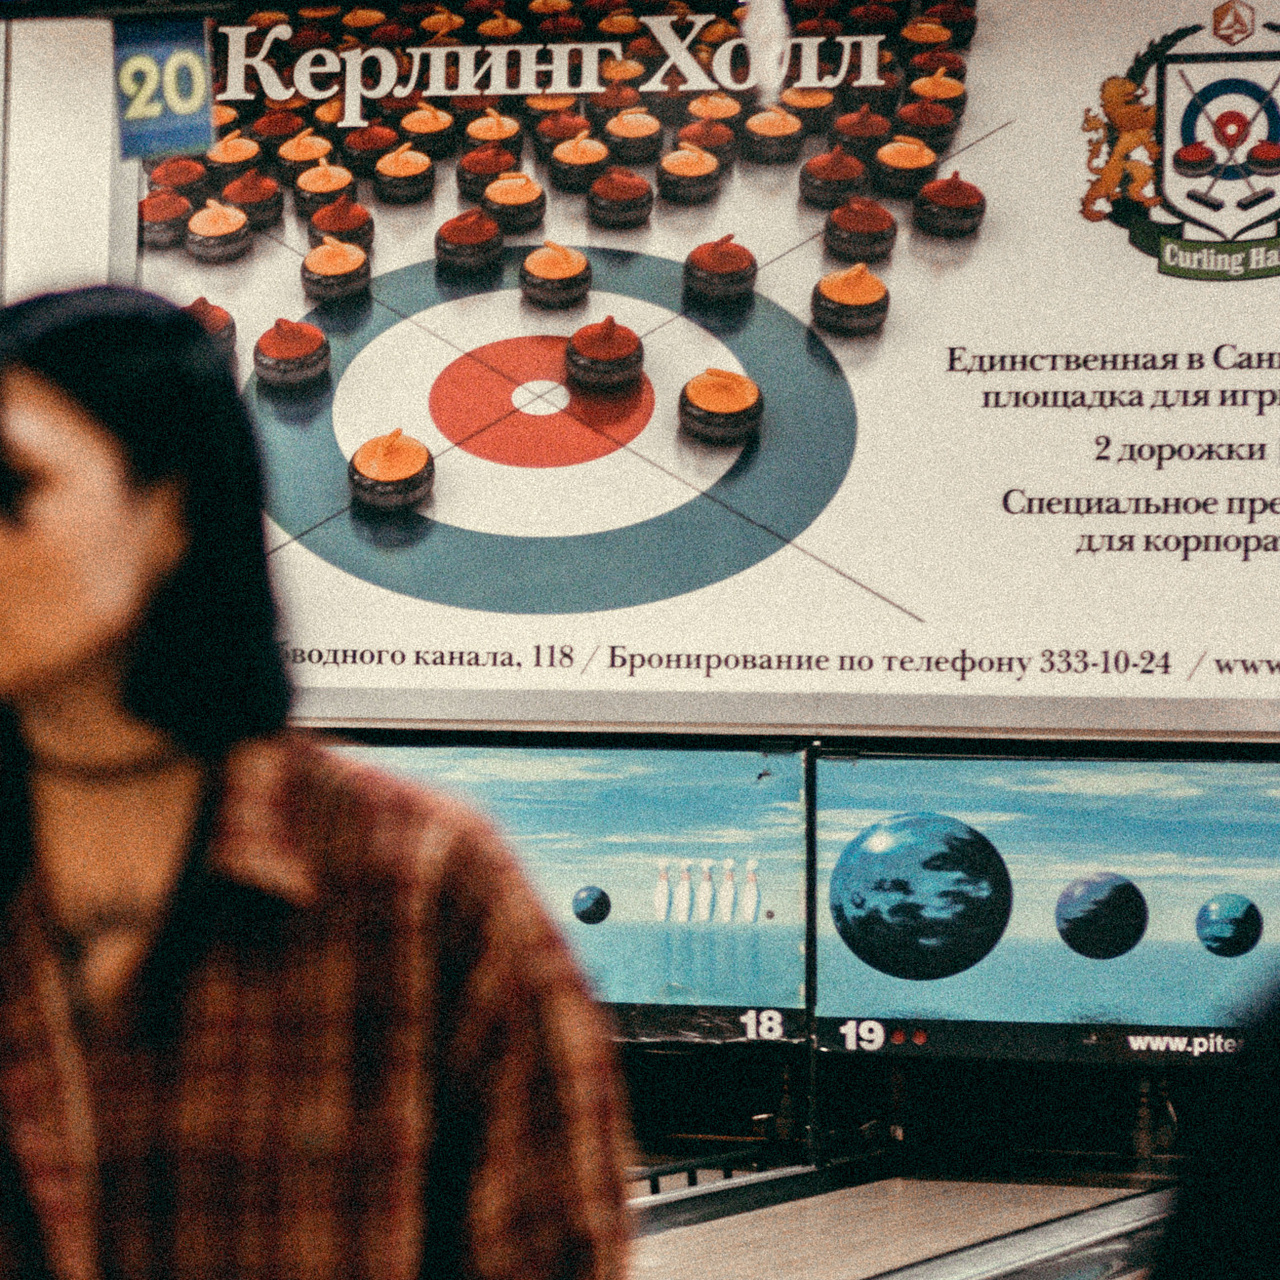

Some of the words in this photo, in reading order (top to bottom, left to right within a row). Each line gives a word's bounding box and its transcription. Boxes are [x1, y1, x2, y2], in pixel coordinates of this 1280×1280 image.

[118, 49, 207, 121] 20
[215, 24, 624, 128] Керлинг
[638, 13, 886, 93] Холл
[1162, 243, 1246, 276] Curling
[946, 346, 1179, 373] Единственная
[1187, 352, 1206, 371] в
[1213, 343, 1280, 371] Сан
[981, 389, 1144, 410] площадка
[1150, 389, 1211, 410] для
[1218, 389, 1280, 417] игр
[1094, 435, 1111, 461] 2
[1117, 443, 1267, 471] дорожки
[1002, 489, 1219, 518] Специальное
[1075, 534, 1135, 555] для
[1143, 533, 1280, 561] корпора
[413, 648, 523, 671] канала,
[532, 644, 575, 668] 118
[607, 646, 830, 677] Бронирование
[838, 653, 874, 673] по
[882, 648, 1031, 682] телефону
[1039, 649, 1172, 675] 333-10-24
[740, 1009, 784, 1040] 18
[838, 1019, 886, 1052] 19
[1126, 1032, 1244, 1058] www.pite
